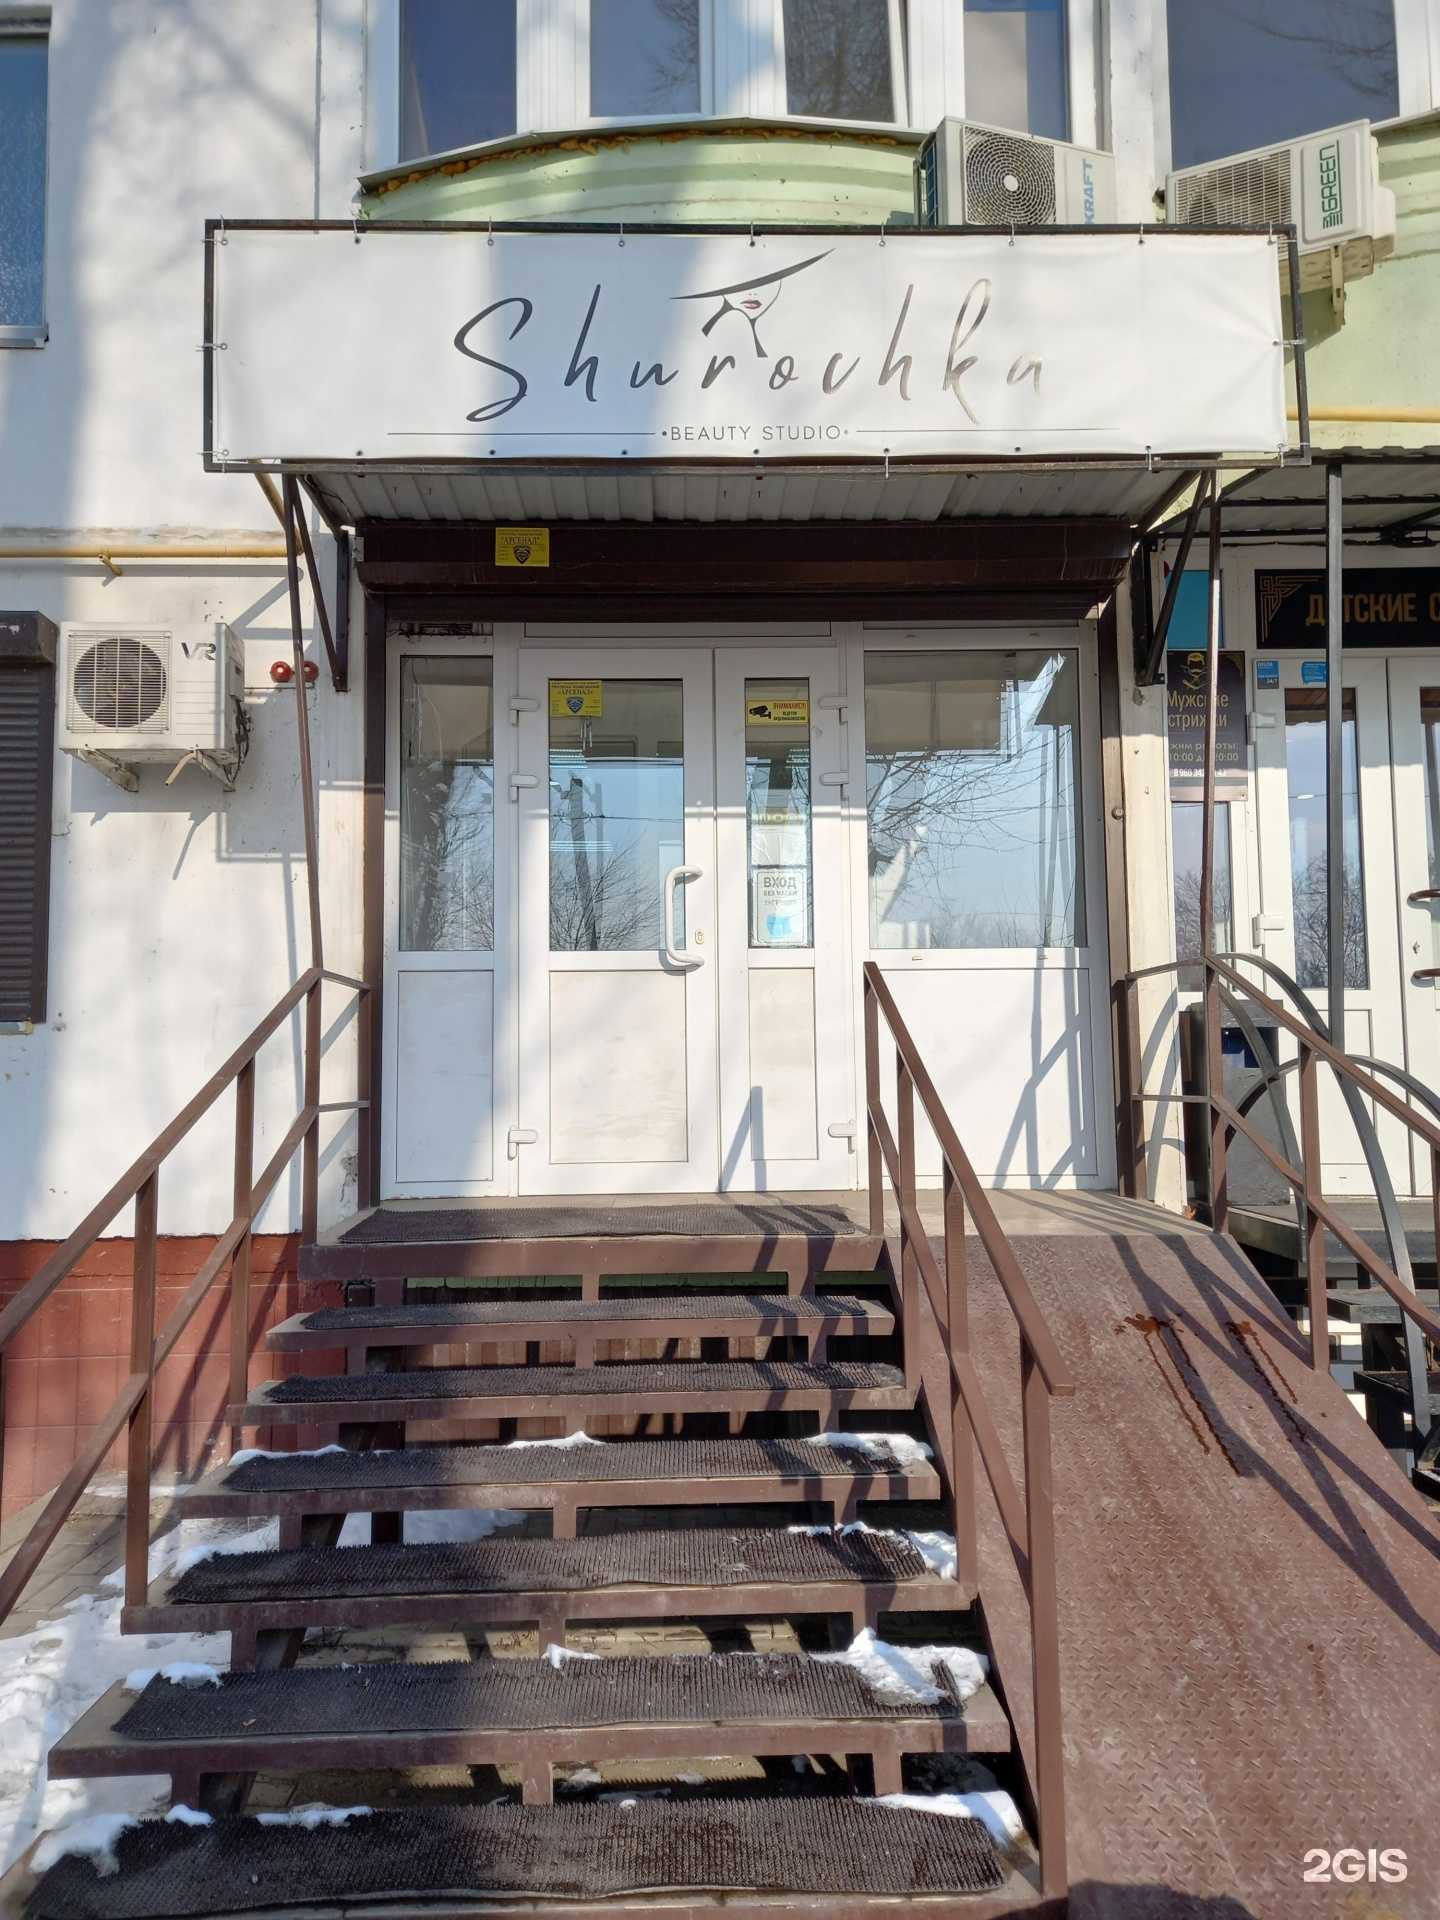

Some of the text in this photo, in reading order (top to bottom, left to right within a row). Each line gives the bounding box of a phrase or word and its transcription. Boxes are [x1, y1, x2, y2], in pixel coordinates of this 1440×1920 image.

[1319, 144, 1339, 213] GREEN
[670, 425, 841, 441] BEAUTY STUDIO
[1305, 592, 1418, 627] ДТСКИЕ
[763, 876, 797, 890] ВХОД
